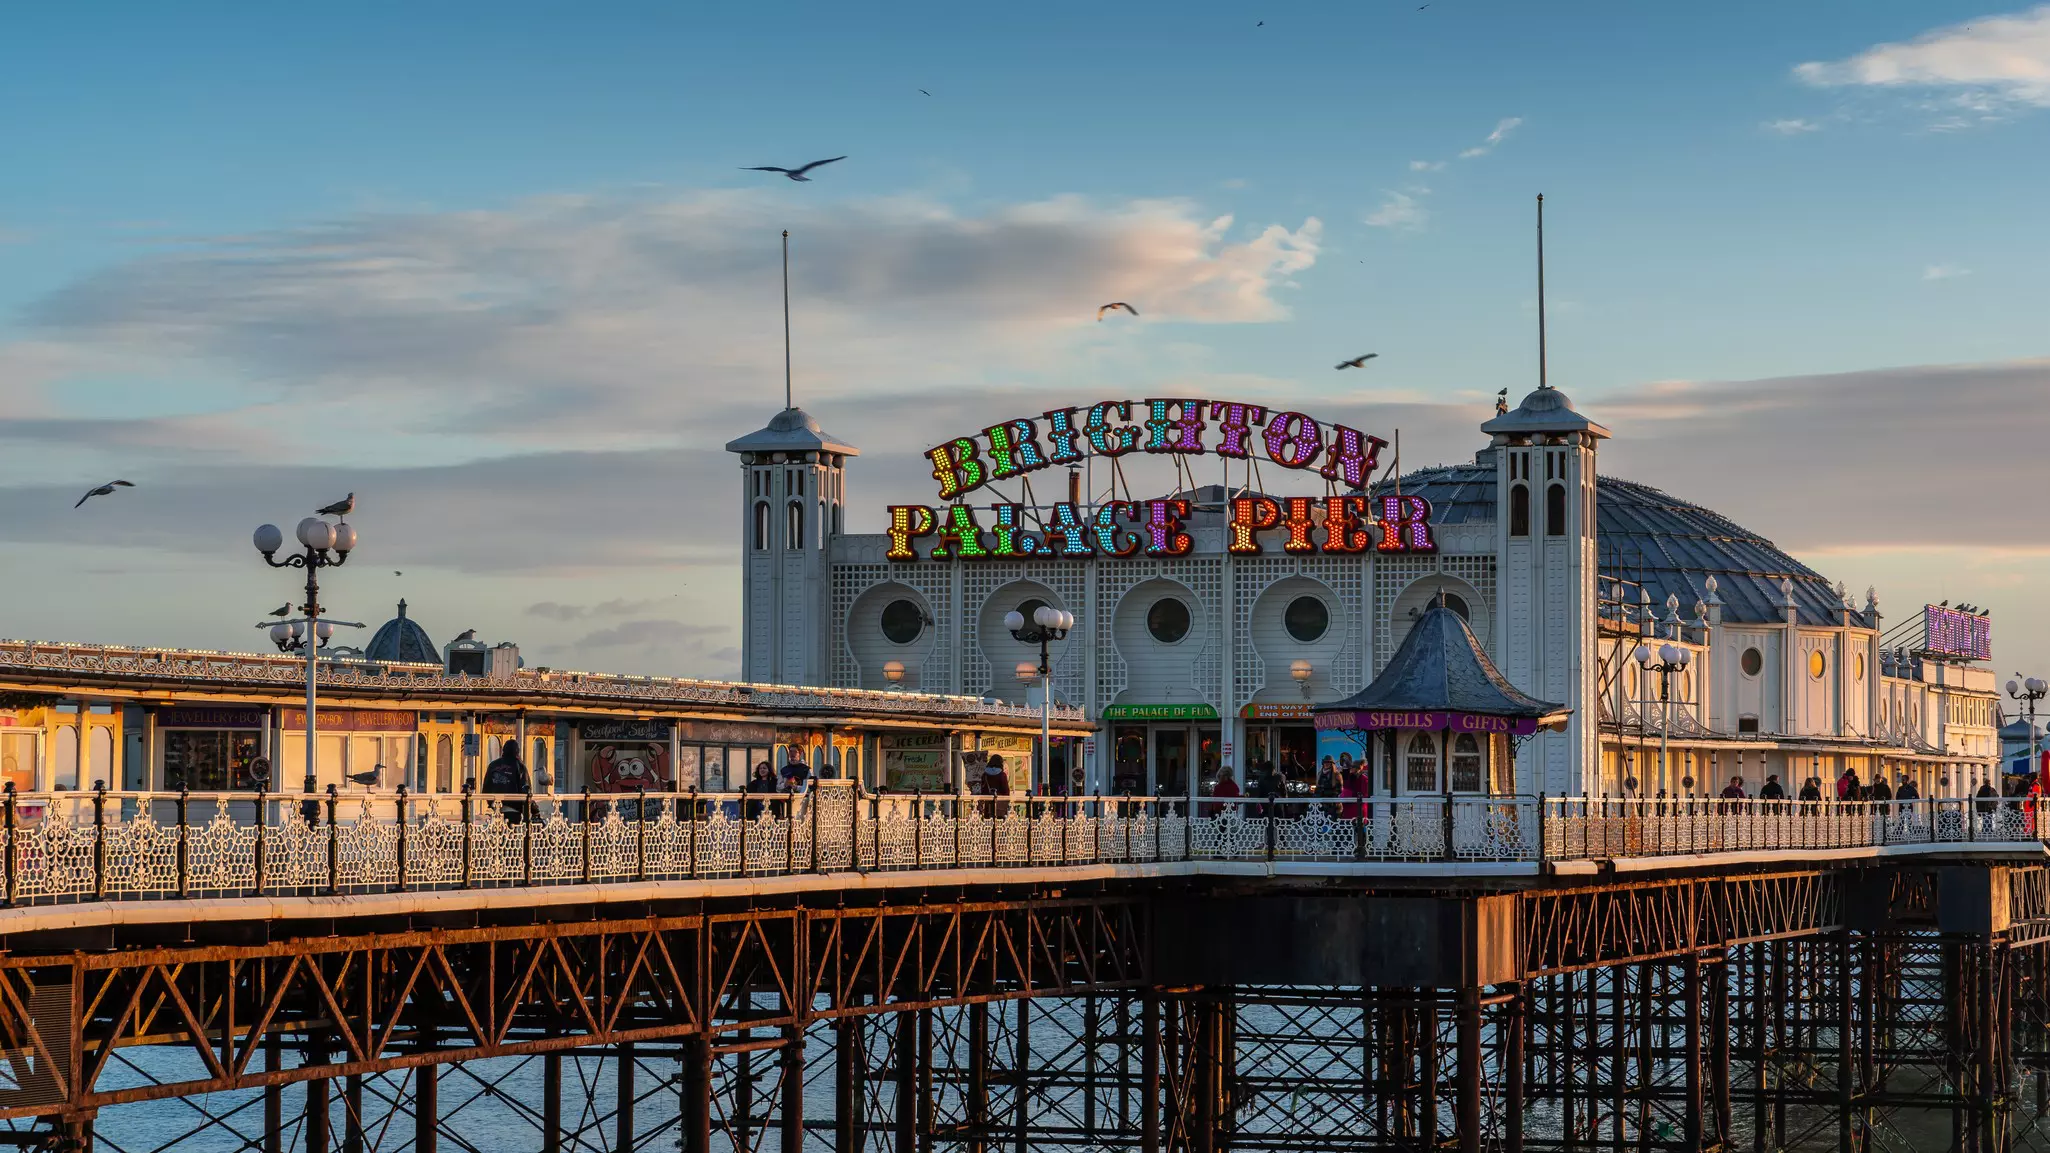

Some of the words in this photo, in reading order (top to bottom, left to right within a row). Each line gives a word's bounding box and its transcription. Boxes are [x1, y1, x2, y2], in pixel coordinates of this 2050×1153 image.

[924, 398, 1389, 500] BRIGHTON
[886, 501, 1195, 562] PALACE
[1227, 496, 1438, 555] PIER
[170, 711, 234, 724] JEWELLERY
[1109, 707, 1127, 717] THE
[1132, 707, 1169, 717] PALACE
[1174, 707, 1186, 717] OF
[1191, 706, 1211, 716] FUN
[329, 713, 343, 725] BOX
[359, 712, 397, 726] JEWELLERY
[398, 713, 414, 725] BOX
[1314, 712, 1356, 729] SOUVENIRS
[1370, 712, 1433, 728] SHELLS
[1463, 714, 1508, 730] GIFTS
[584, 720, 625, 738] Seafood
[896, 736, 913, 747] ICE
[915, 734, 946, 746] CREAM
[981, 736, 996, 748] COFFEE
[1004, 736, 1018, 748] CREAM
